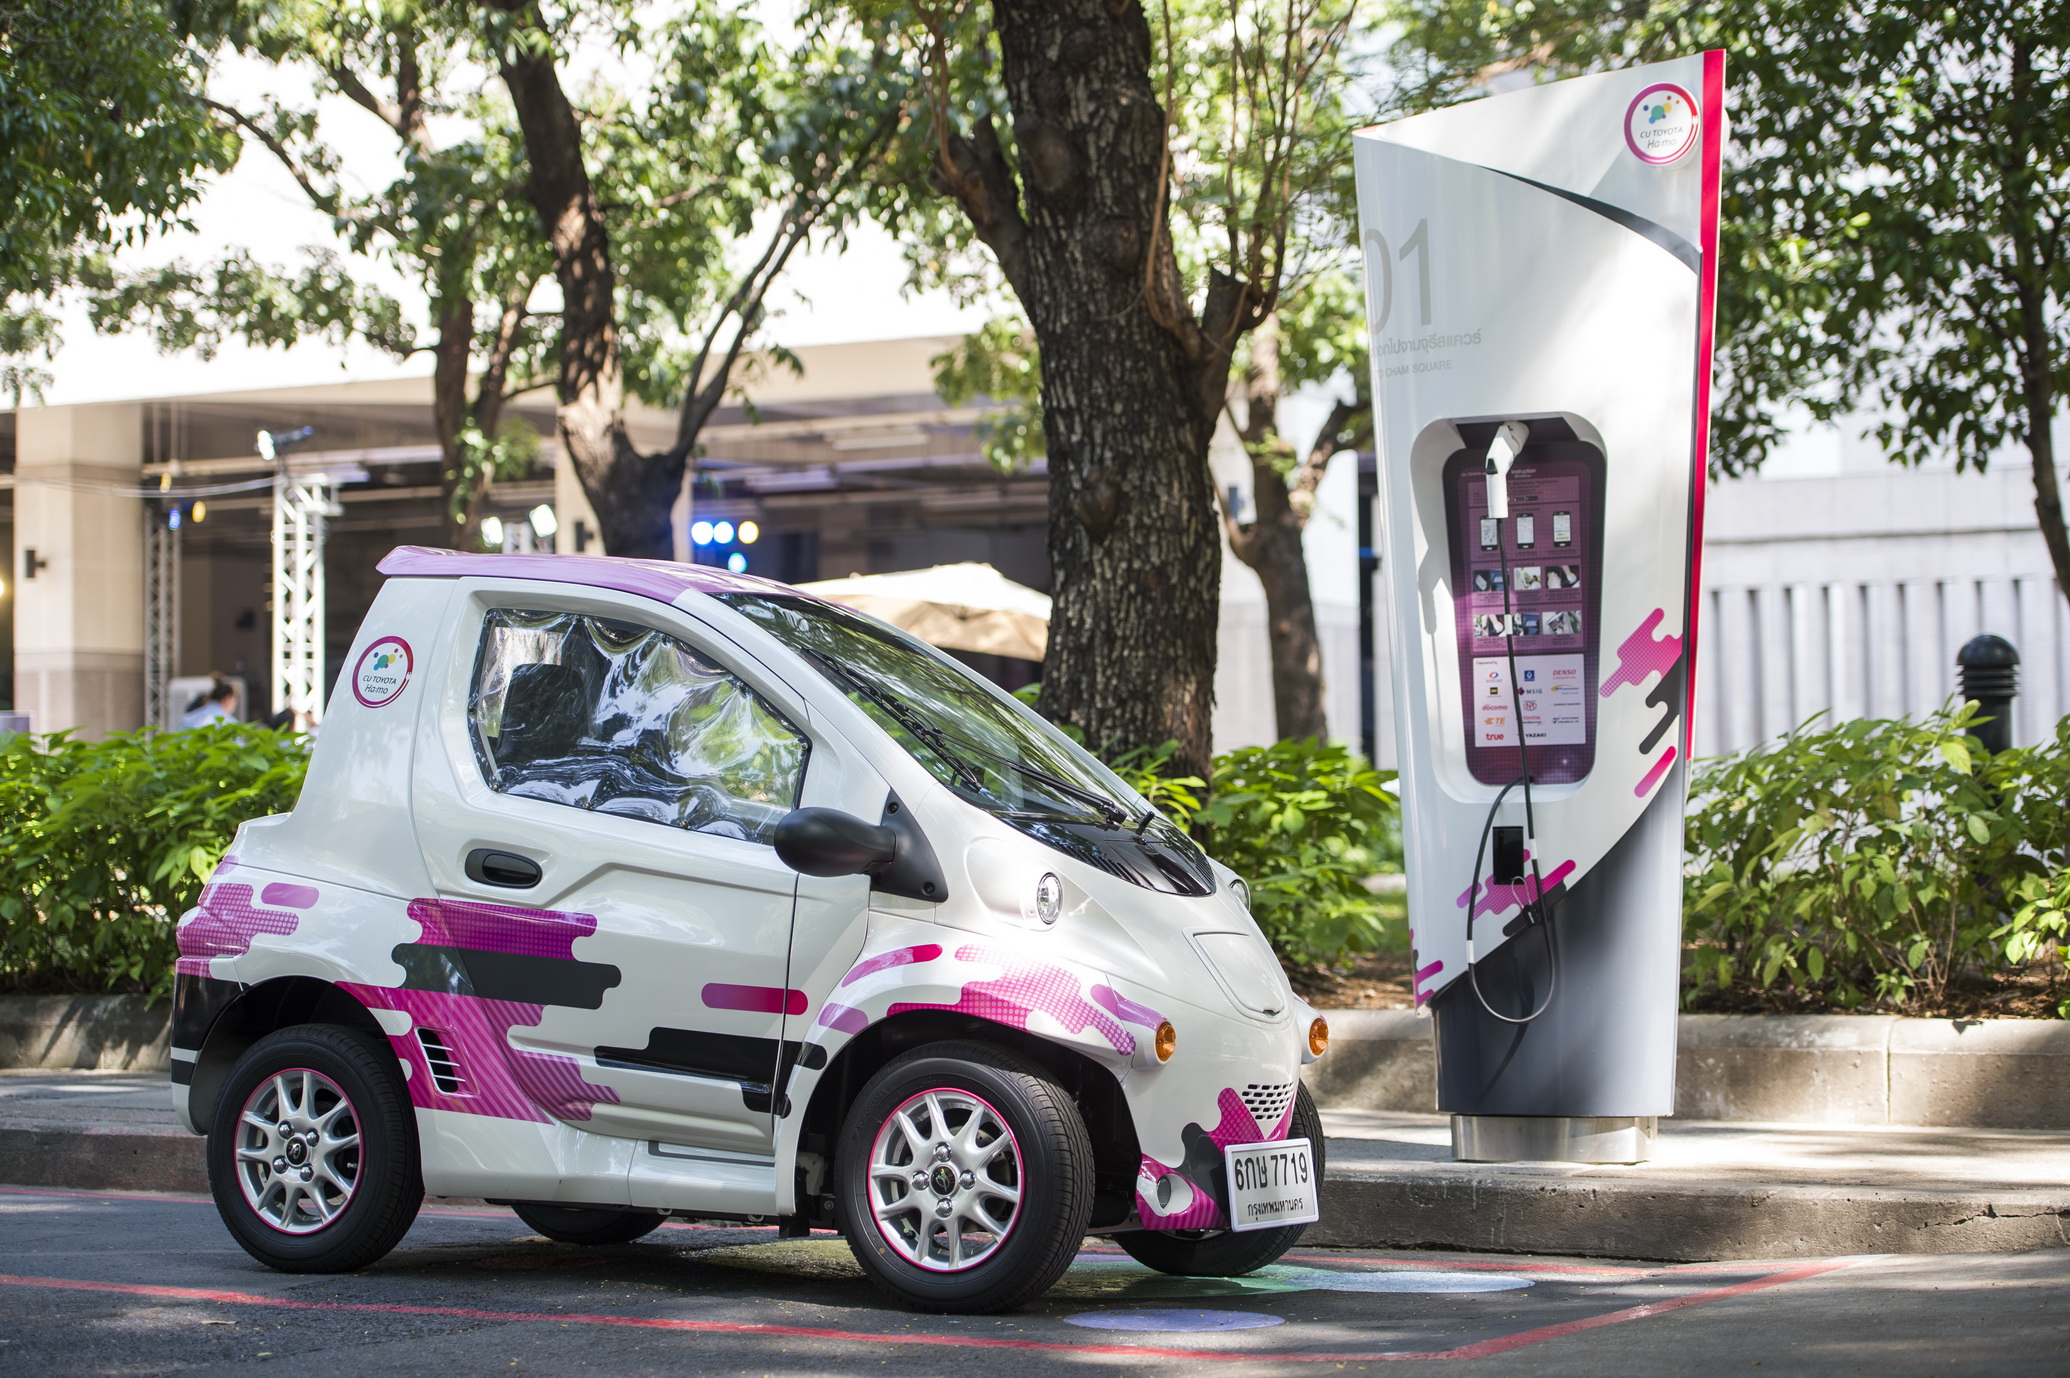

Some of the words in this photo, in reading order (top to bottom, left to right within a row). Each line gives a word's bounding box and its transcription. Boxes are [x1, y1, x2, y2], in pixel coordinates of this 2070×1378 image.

[1640, 130, 1652, 138] CU
[1653, 126, 1683, 137] TOYOTA
[1364, 218, 1432, 336] 01
[1385, 365, 1409, 378] CHAM
[1412, 360, 1453, 374] SQUARE
[363, 674, 372, 682] CU
[372, 676, 397, 685] TOYOTA
[1486, 732, 1505, 741] true
[1271, 1152, 1308, 1187] 7719
[1247, 1197, 1304, 1221] กรุงเทพมหานคร
